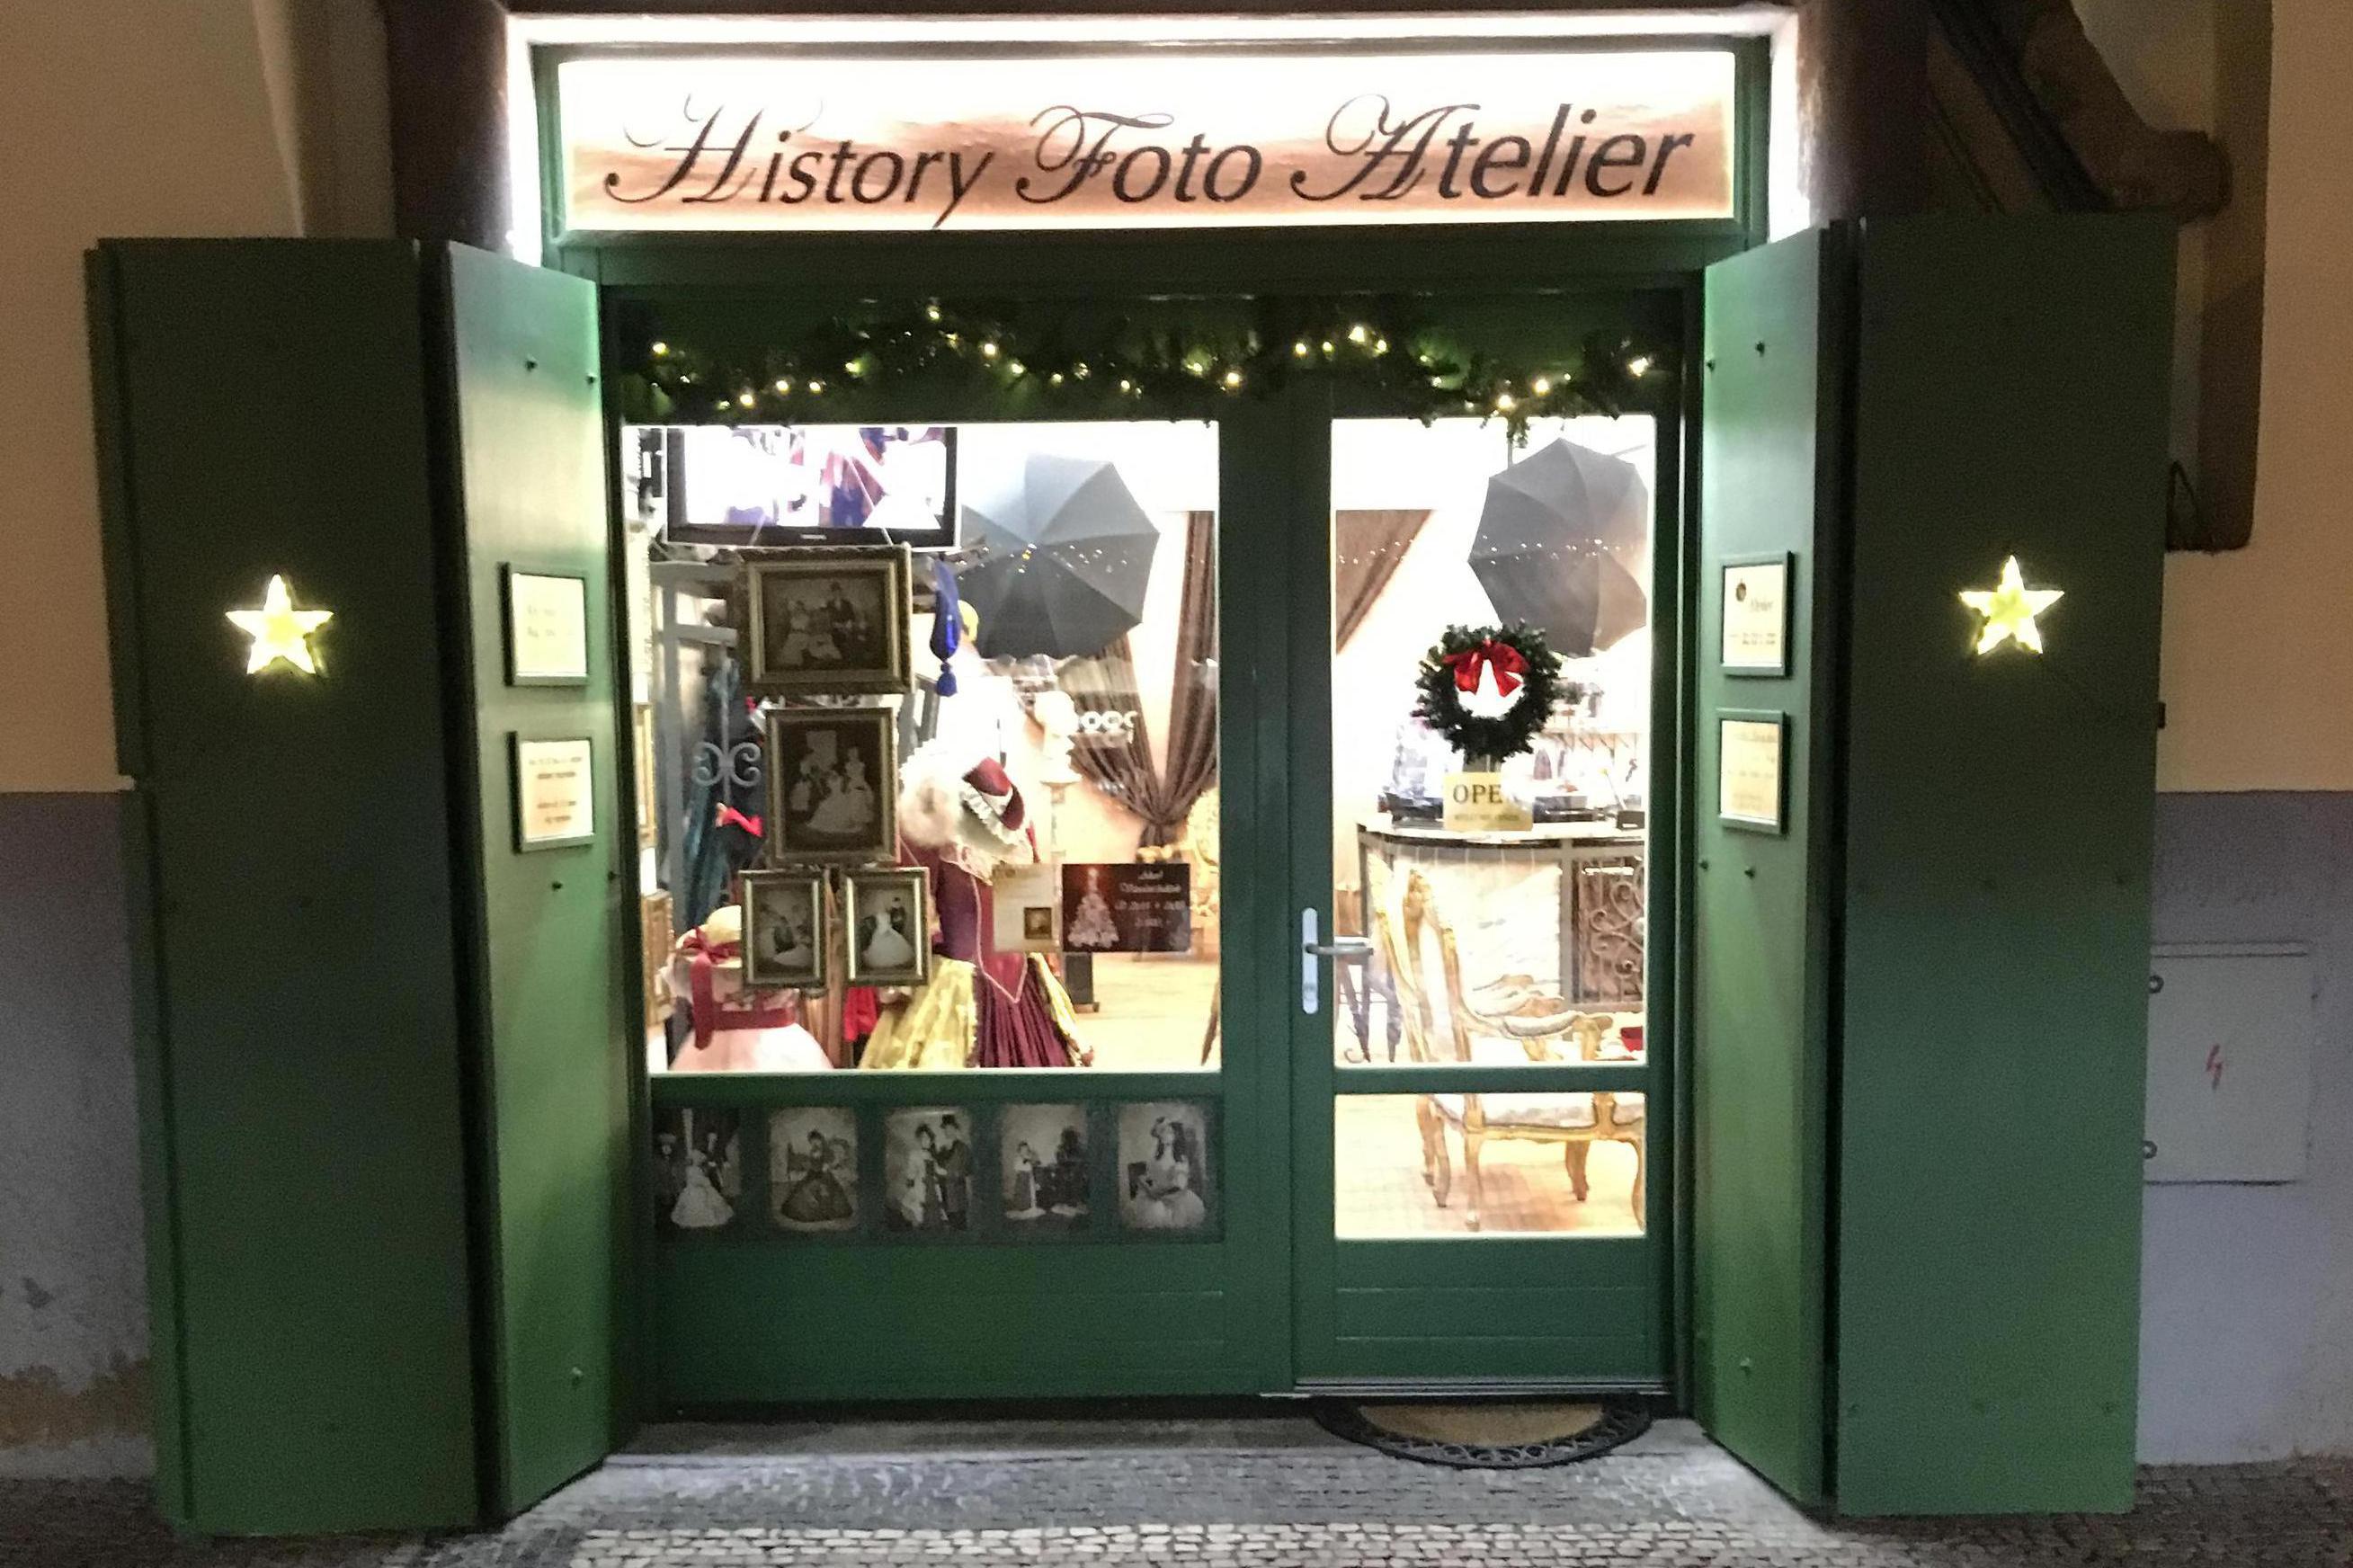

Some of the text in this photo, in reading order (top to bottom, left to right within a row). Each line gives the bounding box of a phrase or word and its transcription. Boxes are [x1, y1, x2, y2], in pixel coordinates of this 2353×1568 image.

[604, 92, 1695, 230] History Foto Atelier
[1453, 784, 1522, 804] OPE
